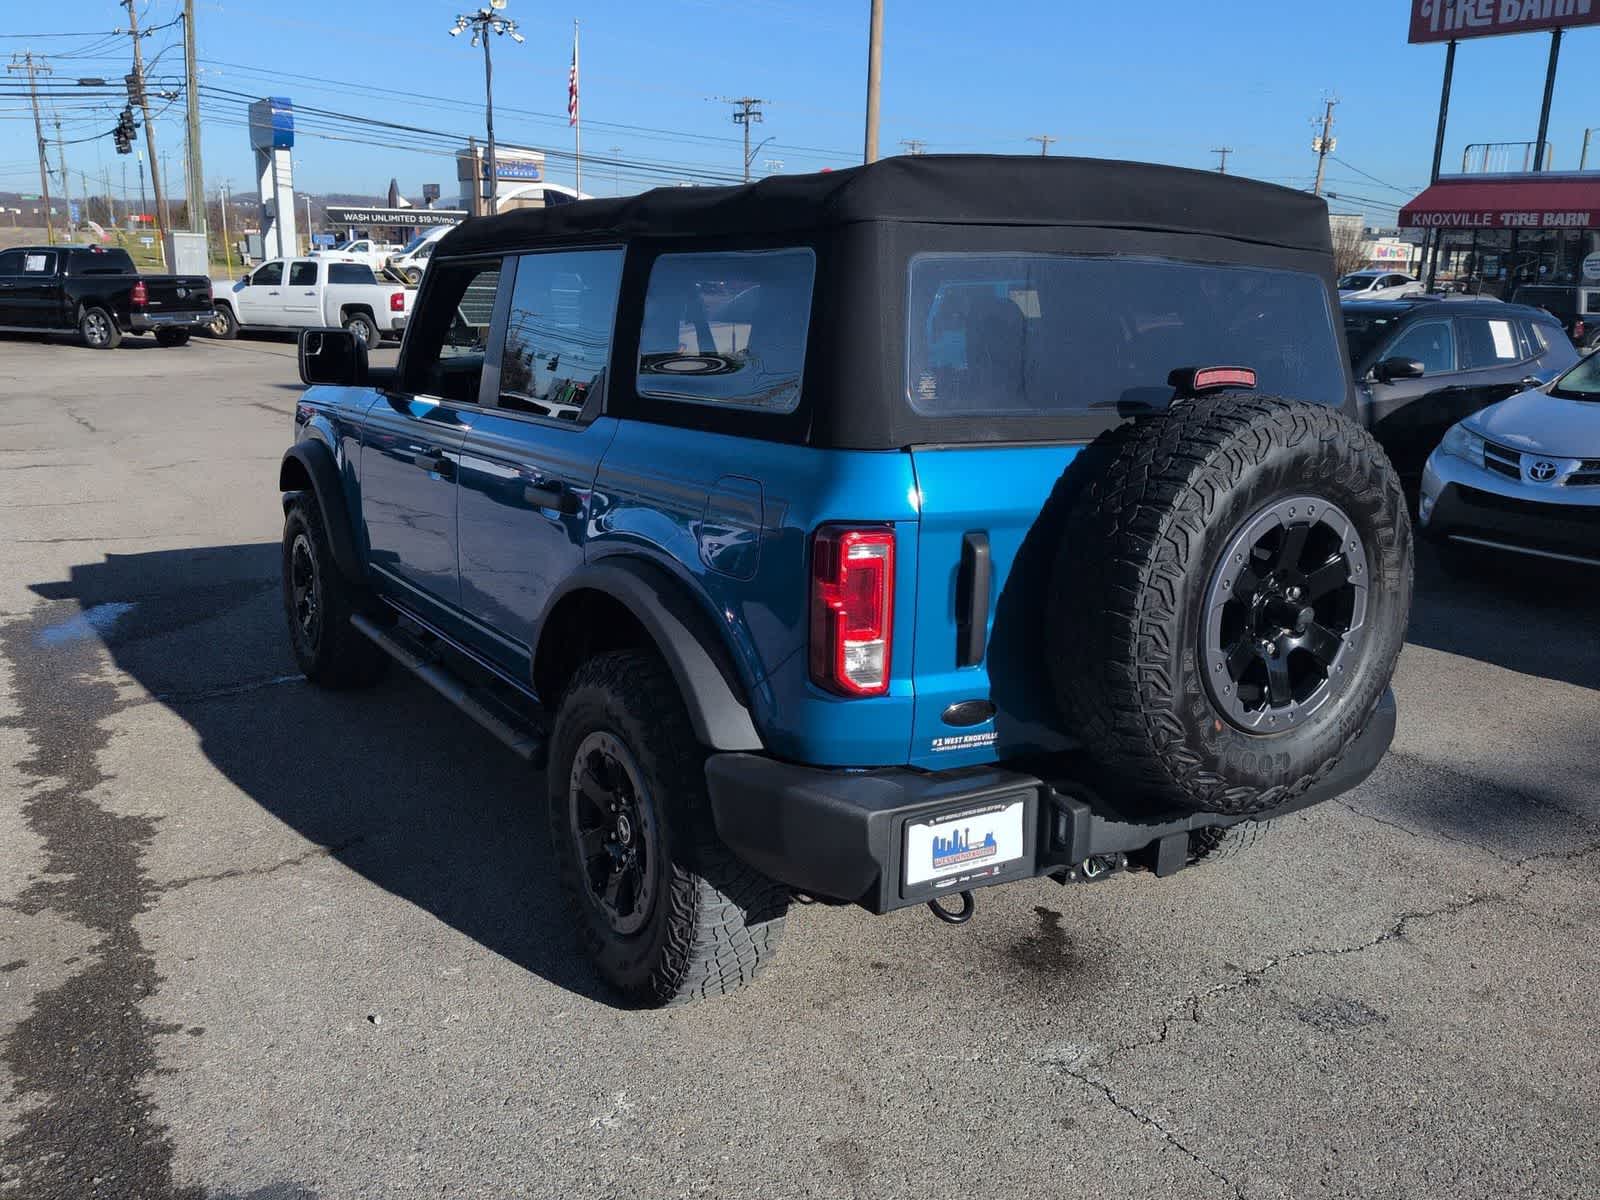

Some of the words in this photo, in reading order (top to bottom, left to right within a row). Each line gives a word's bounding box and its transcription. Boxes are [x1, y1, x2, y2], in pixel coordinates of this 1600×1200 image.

[343, 213, 370, 222] WASH
[371, 213, 416, 223] UNLIMITED
[1411, 213, 1493, 226] KNOXVILLE
[1542, 212, 1591, 226] BARN
[932, 737, 944, 747] #1
[944, 736, 963, 746] WEST
